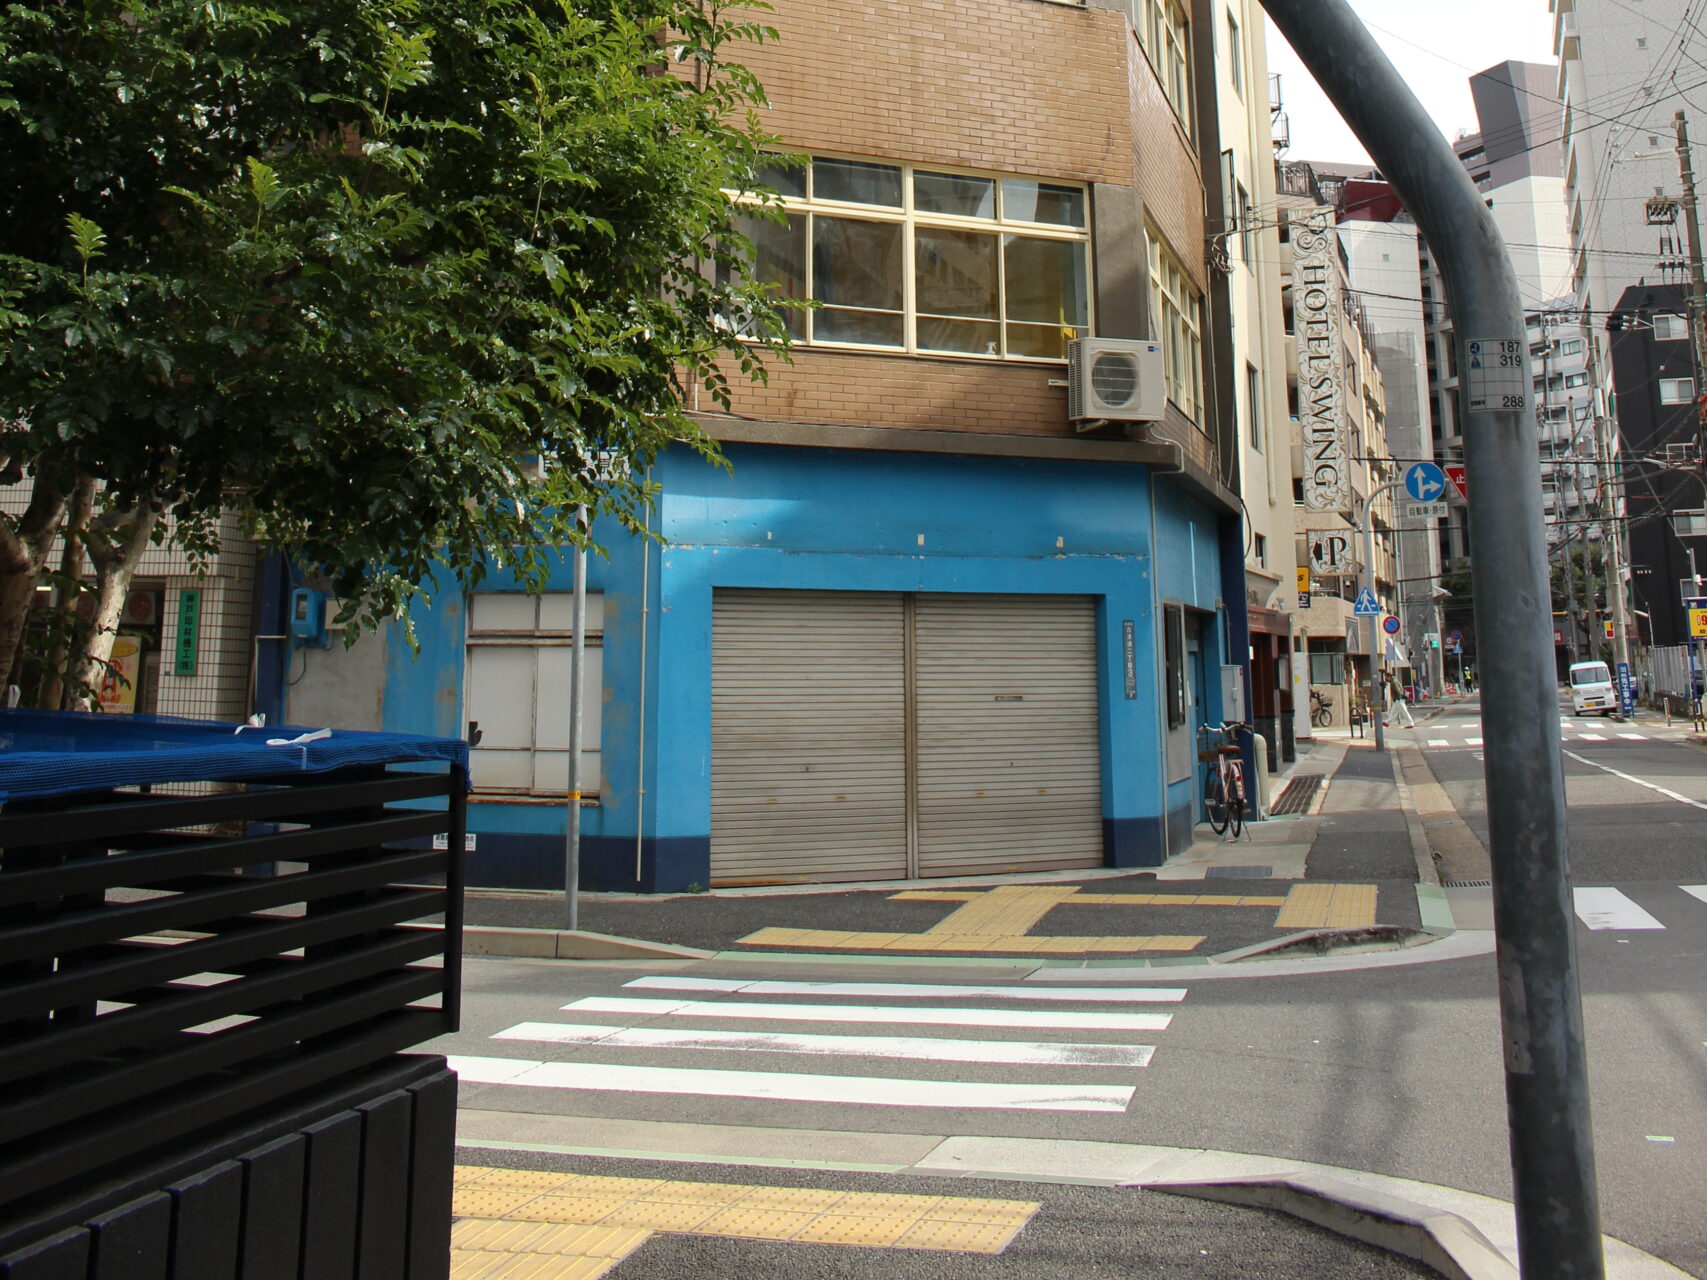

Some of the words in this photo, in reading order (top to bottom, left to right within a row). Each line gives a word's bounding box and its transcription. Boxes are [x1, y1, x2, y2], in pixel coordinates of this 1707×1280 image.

[1302, 264, 1331, 363] HOTEL
[1500, 341, 1520, 353] 187
[1500, 354, 1521, 366] 319
[1502, 395, 1524, 408] 288
[1325, 536, 1347, 566] P
